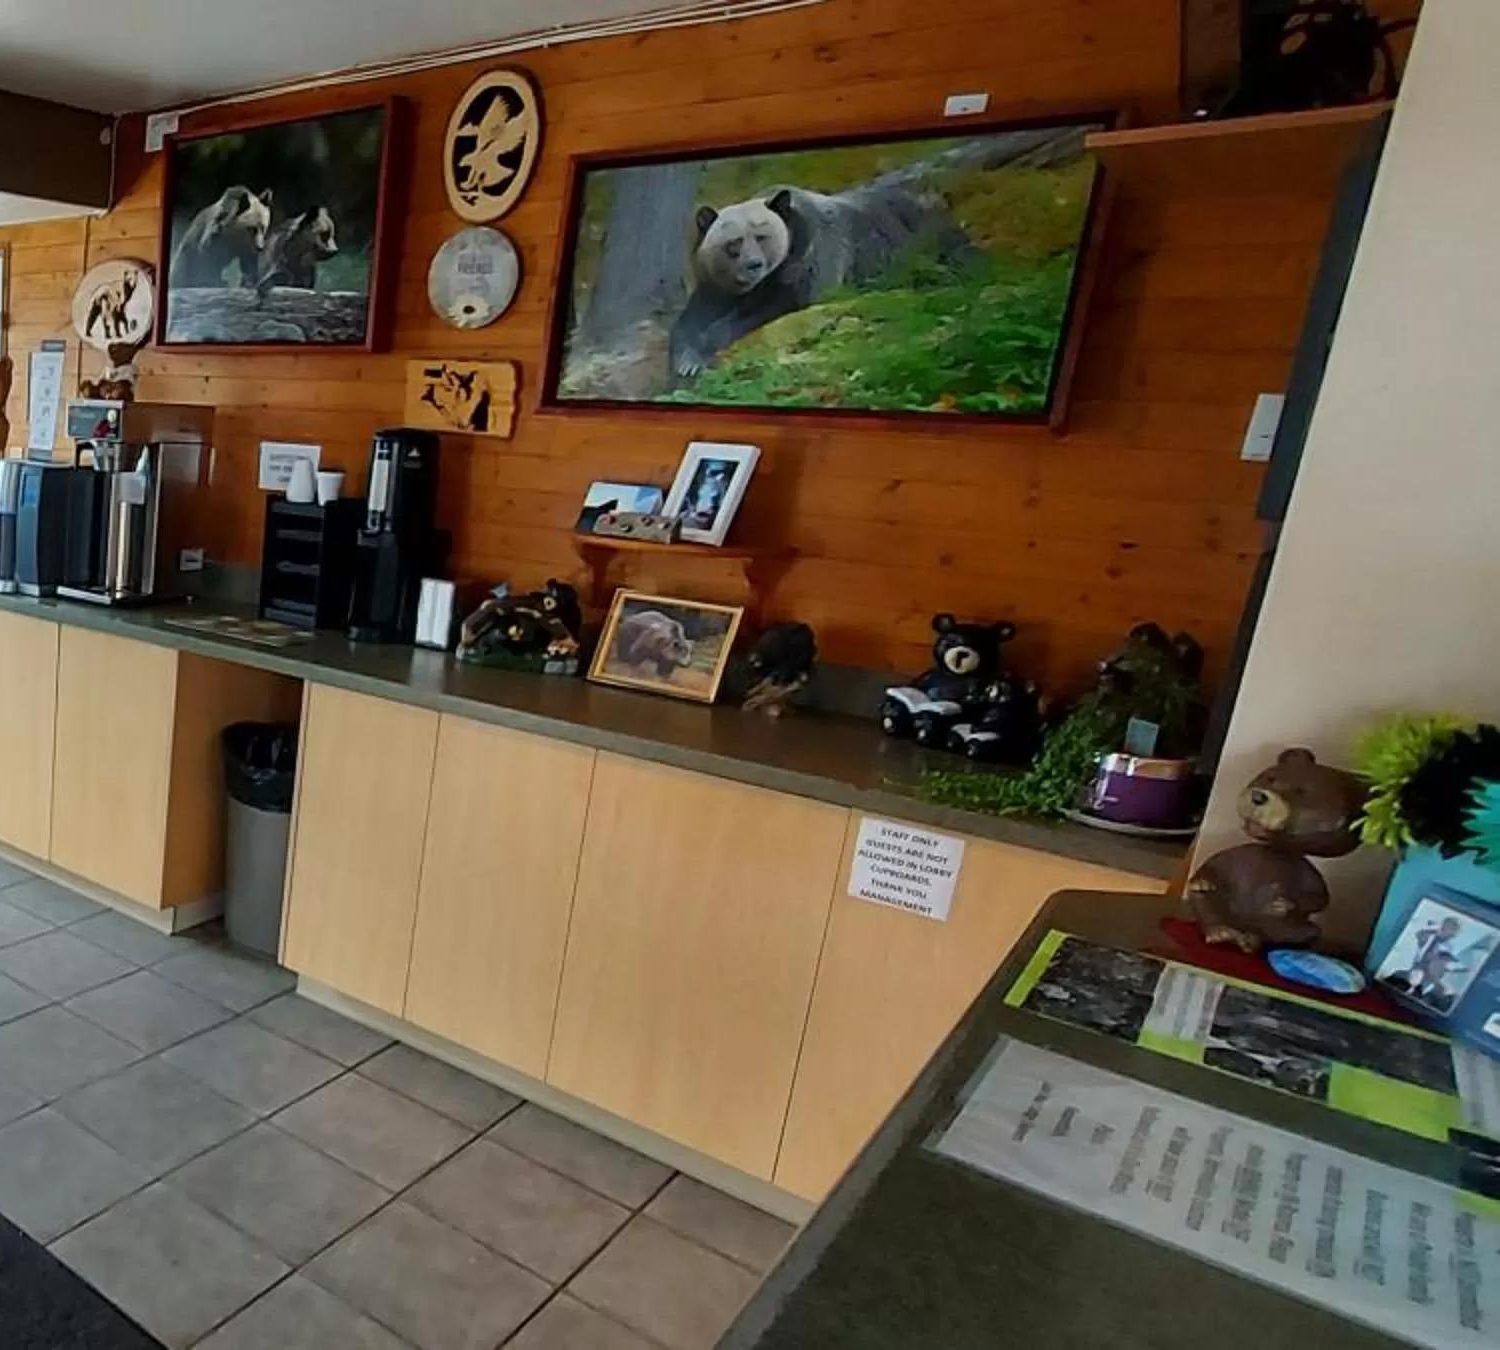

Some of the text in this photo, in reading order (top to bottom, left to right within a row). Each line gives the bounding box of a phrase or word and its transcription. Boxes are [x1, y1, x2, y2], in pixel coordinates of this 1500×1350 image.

[882, 828, 939, 847] STAFF ONLY
[858, 850, 952, 879] ALLOWED IN LOBBY
[865, 839, 949, 866] GUESTS ARE NOT
[871, 878, 927, 899] THANK YOU
[860, 889, 932, 914] MANAGEMENT
